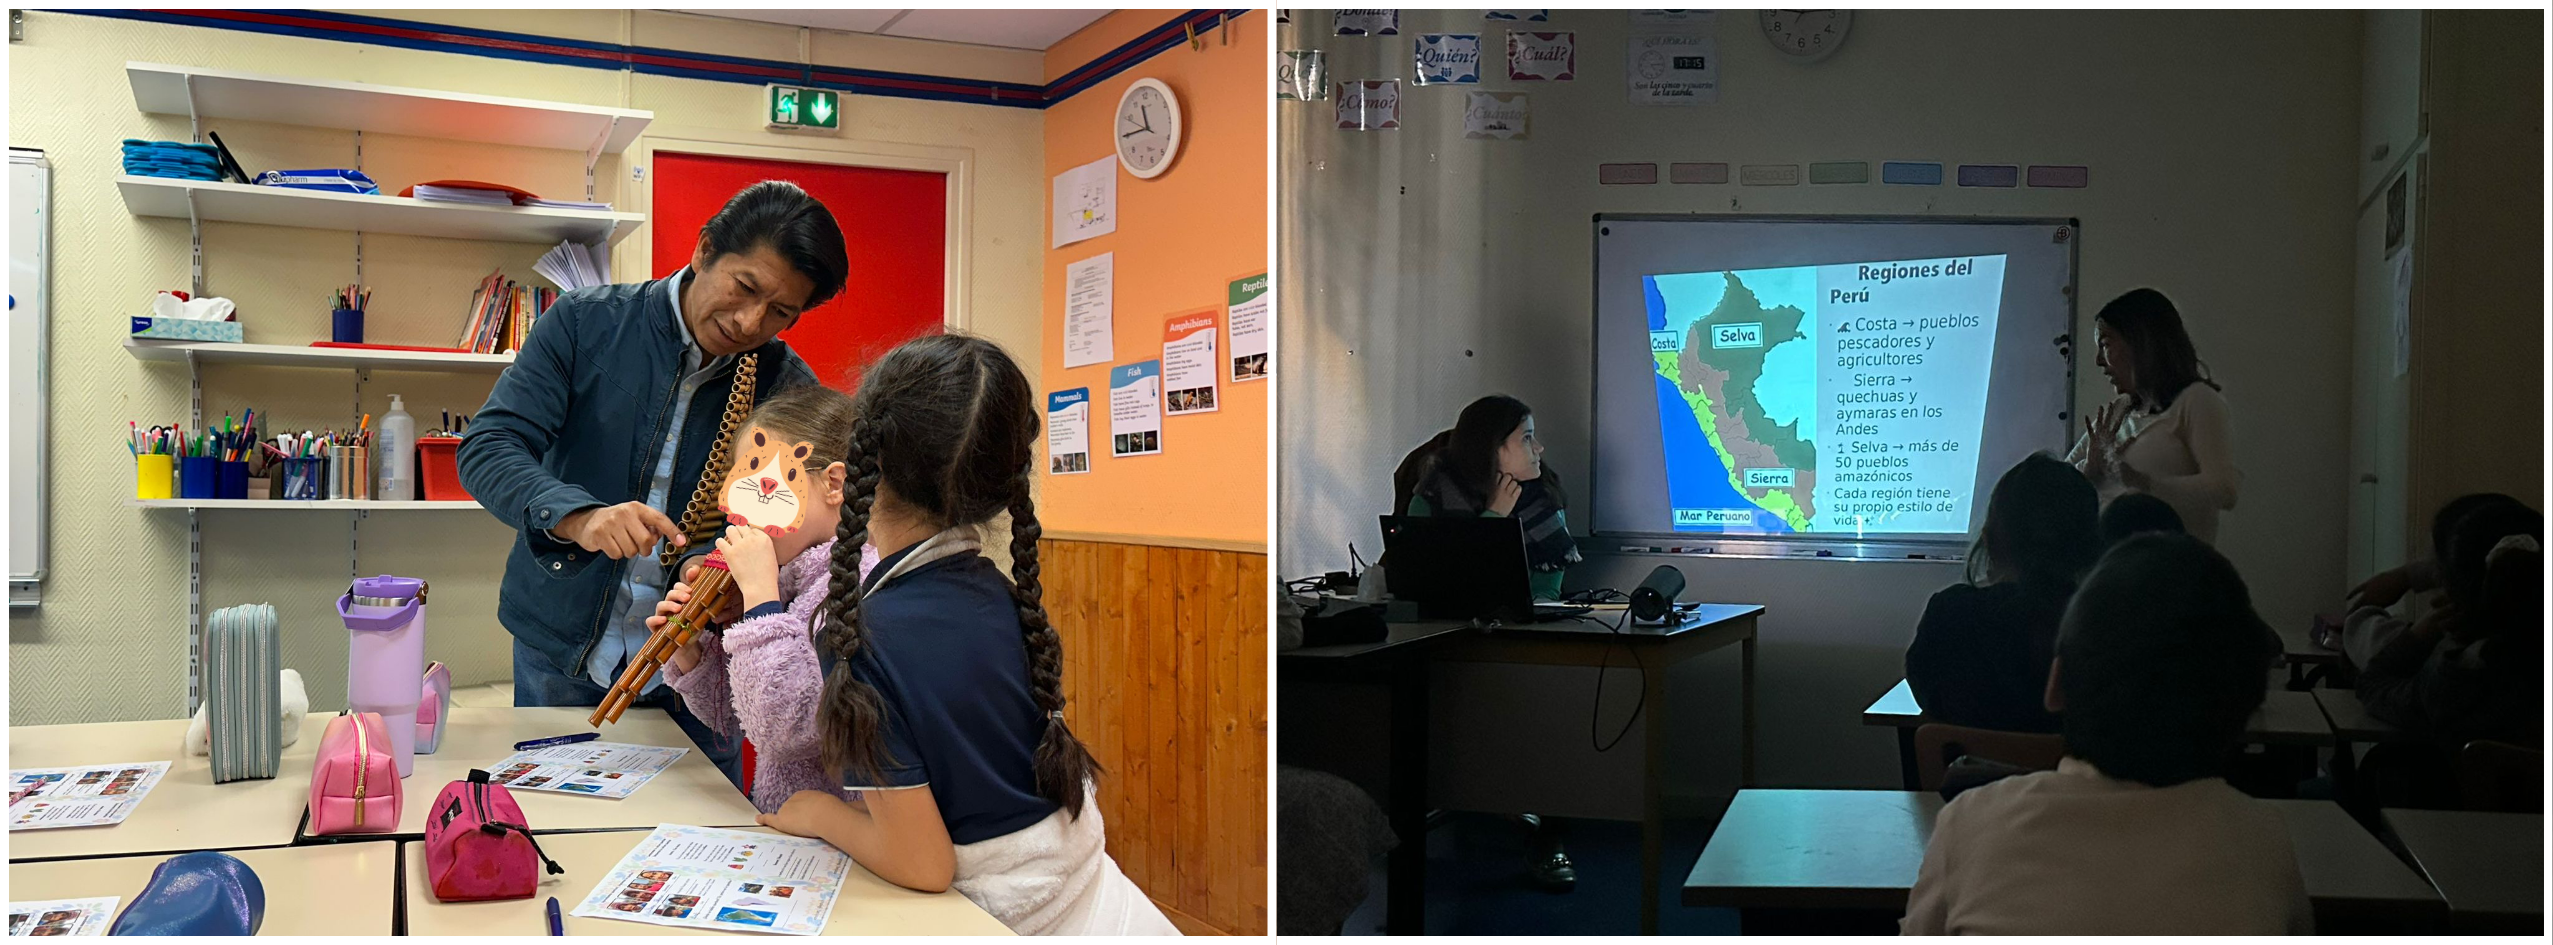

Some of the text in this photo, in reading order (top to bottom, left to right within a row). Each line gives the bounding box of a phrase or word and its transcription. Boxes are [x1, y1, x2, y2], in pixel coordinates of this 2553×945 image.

[1774, 21, 1781, 32] 8
[1824, 24, 1831, 34] 4
[1785, 33, 1792, 42] 7
[1797, 37, 1805, 48] 6
[1814, 34, 1821, 44] 5
[1515, 45, 1568, 64] ¿Cuál?
[1858, 258, 1973, 284] Regiones del
[1830, 287, 1869, 304] Perú
[1169, 318, 1212, 332] Amphibians
[1855, 313, 1979, 332] Costa pueblos
[1720, 328, 1756, 342] Selva
[1652, 337, 1677, 350] Costa
[1838, 334, 1935, 353] pescadores y
[1837, 352, 1923, 369] agricultores
[1127, 367, 1142, 378] Fish
[1853, 373, 1895, 387] Sierra
[1054, 391, 1082, 404] Mammals
[1836, 391, 1918, 406] quechuas y
[1836, 405, 1942, 422] aymaras en los
[1836, 423, 1878, 435] Andes
[1851, 439, 1959, 453] Selva más de
[1835, 456, 1909, 470] 50 pueblos
[1750, 473, 1789, 484] Sierra
[1834, 469, 1913, 482] amazónicos
[1834, 487, 1951, 501] Cada región tiene
[1834, 501, 1953, 514] su propio estilo de
[1680, 510, 1750, 521] Mar Peruano
[1834, 515, 1858, 526] vida
